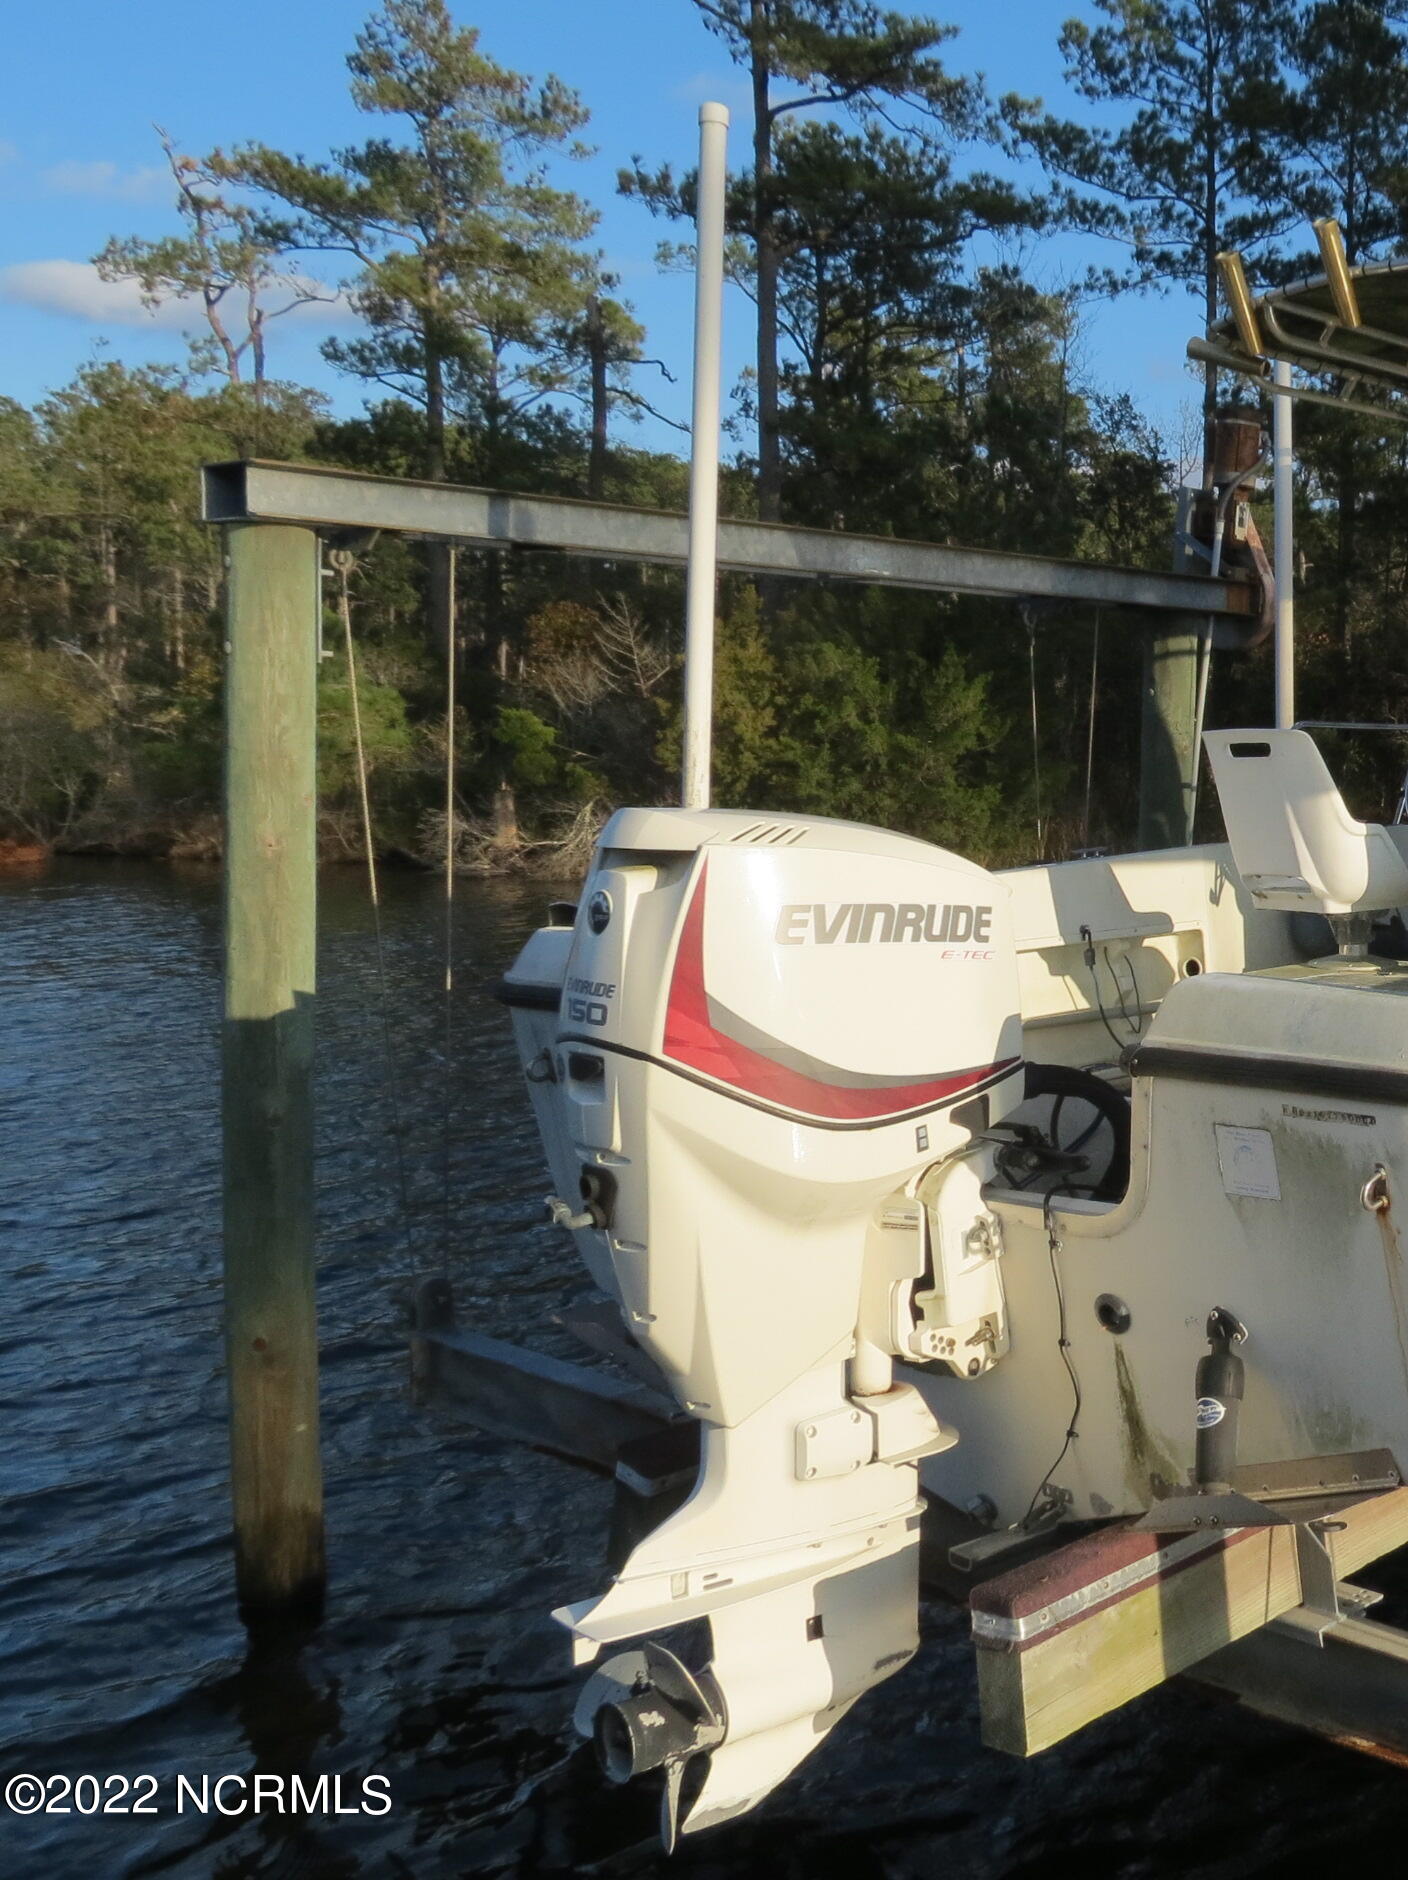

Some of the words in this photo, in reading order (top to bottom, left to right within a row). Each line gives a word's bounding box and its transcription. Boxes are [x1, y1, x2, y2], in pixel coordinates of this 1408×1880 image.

[775, 903, 993, 945] EVINRUDE
[940, 950, 996, 961] E-TEC
[568, 998, 608, 1026] 150
